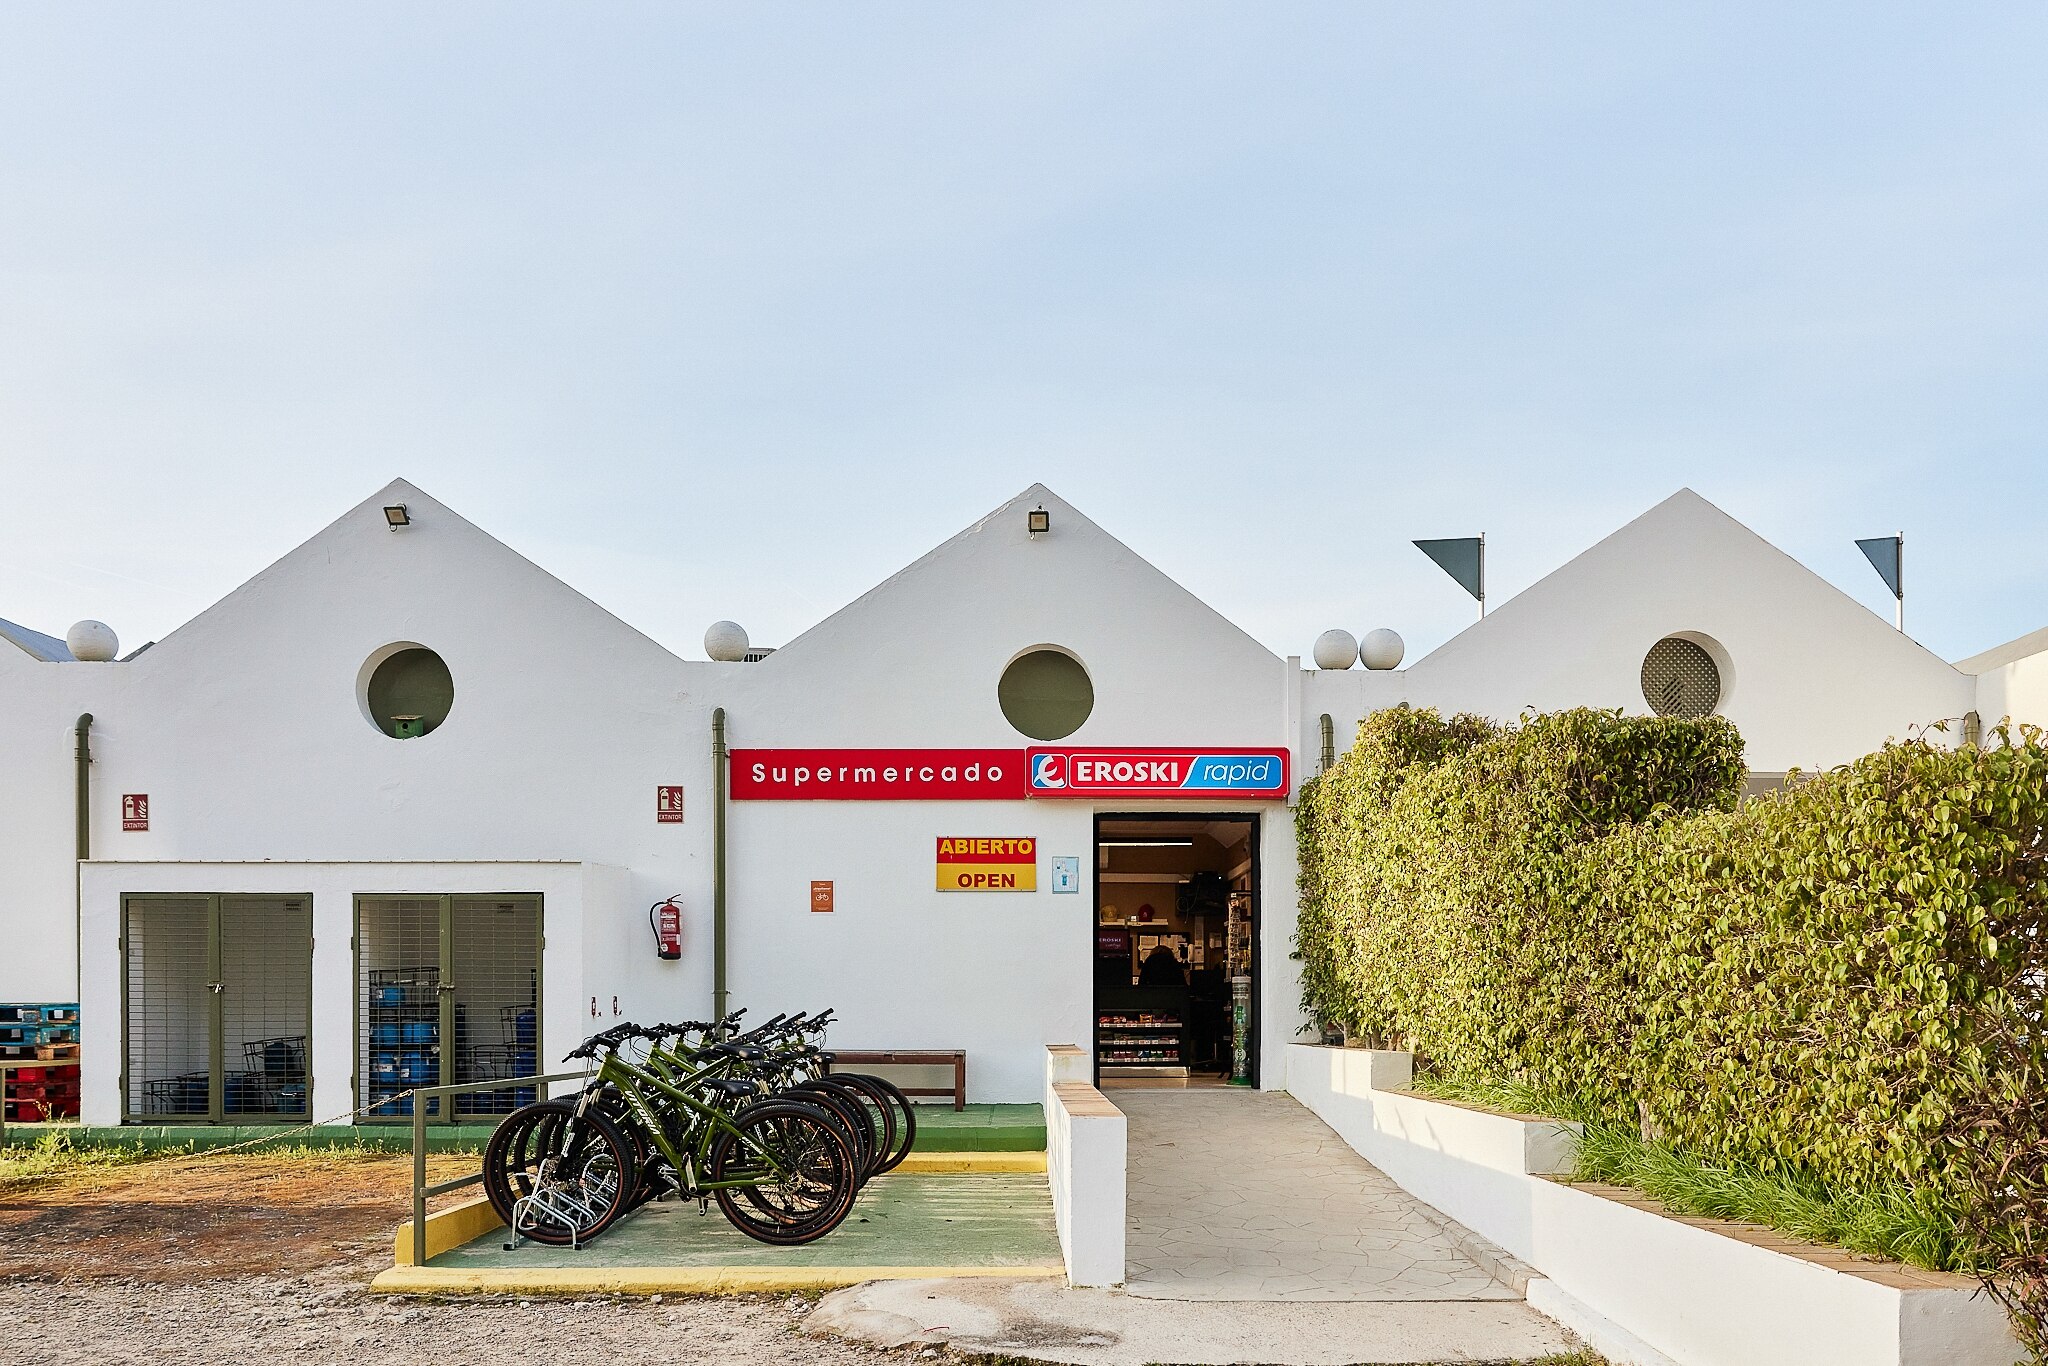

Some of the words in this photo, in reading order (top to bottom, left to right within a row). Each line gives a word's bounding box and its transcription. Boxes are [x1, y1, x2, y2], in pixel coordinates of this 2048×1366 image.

[752, 763, 1003, 786] Supermercado
[1077, 761, 1179, 783] EROSKI
[1203, 760, 1270, 786] rapid
[940, 839, 1033, 855] ABIERTO
[957, 873, 1016, 888] OPEN
